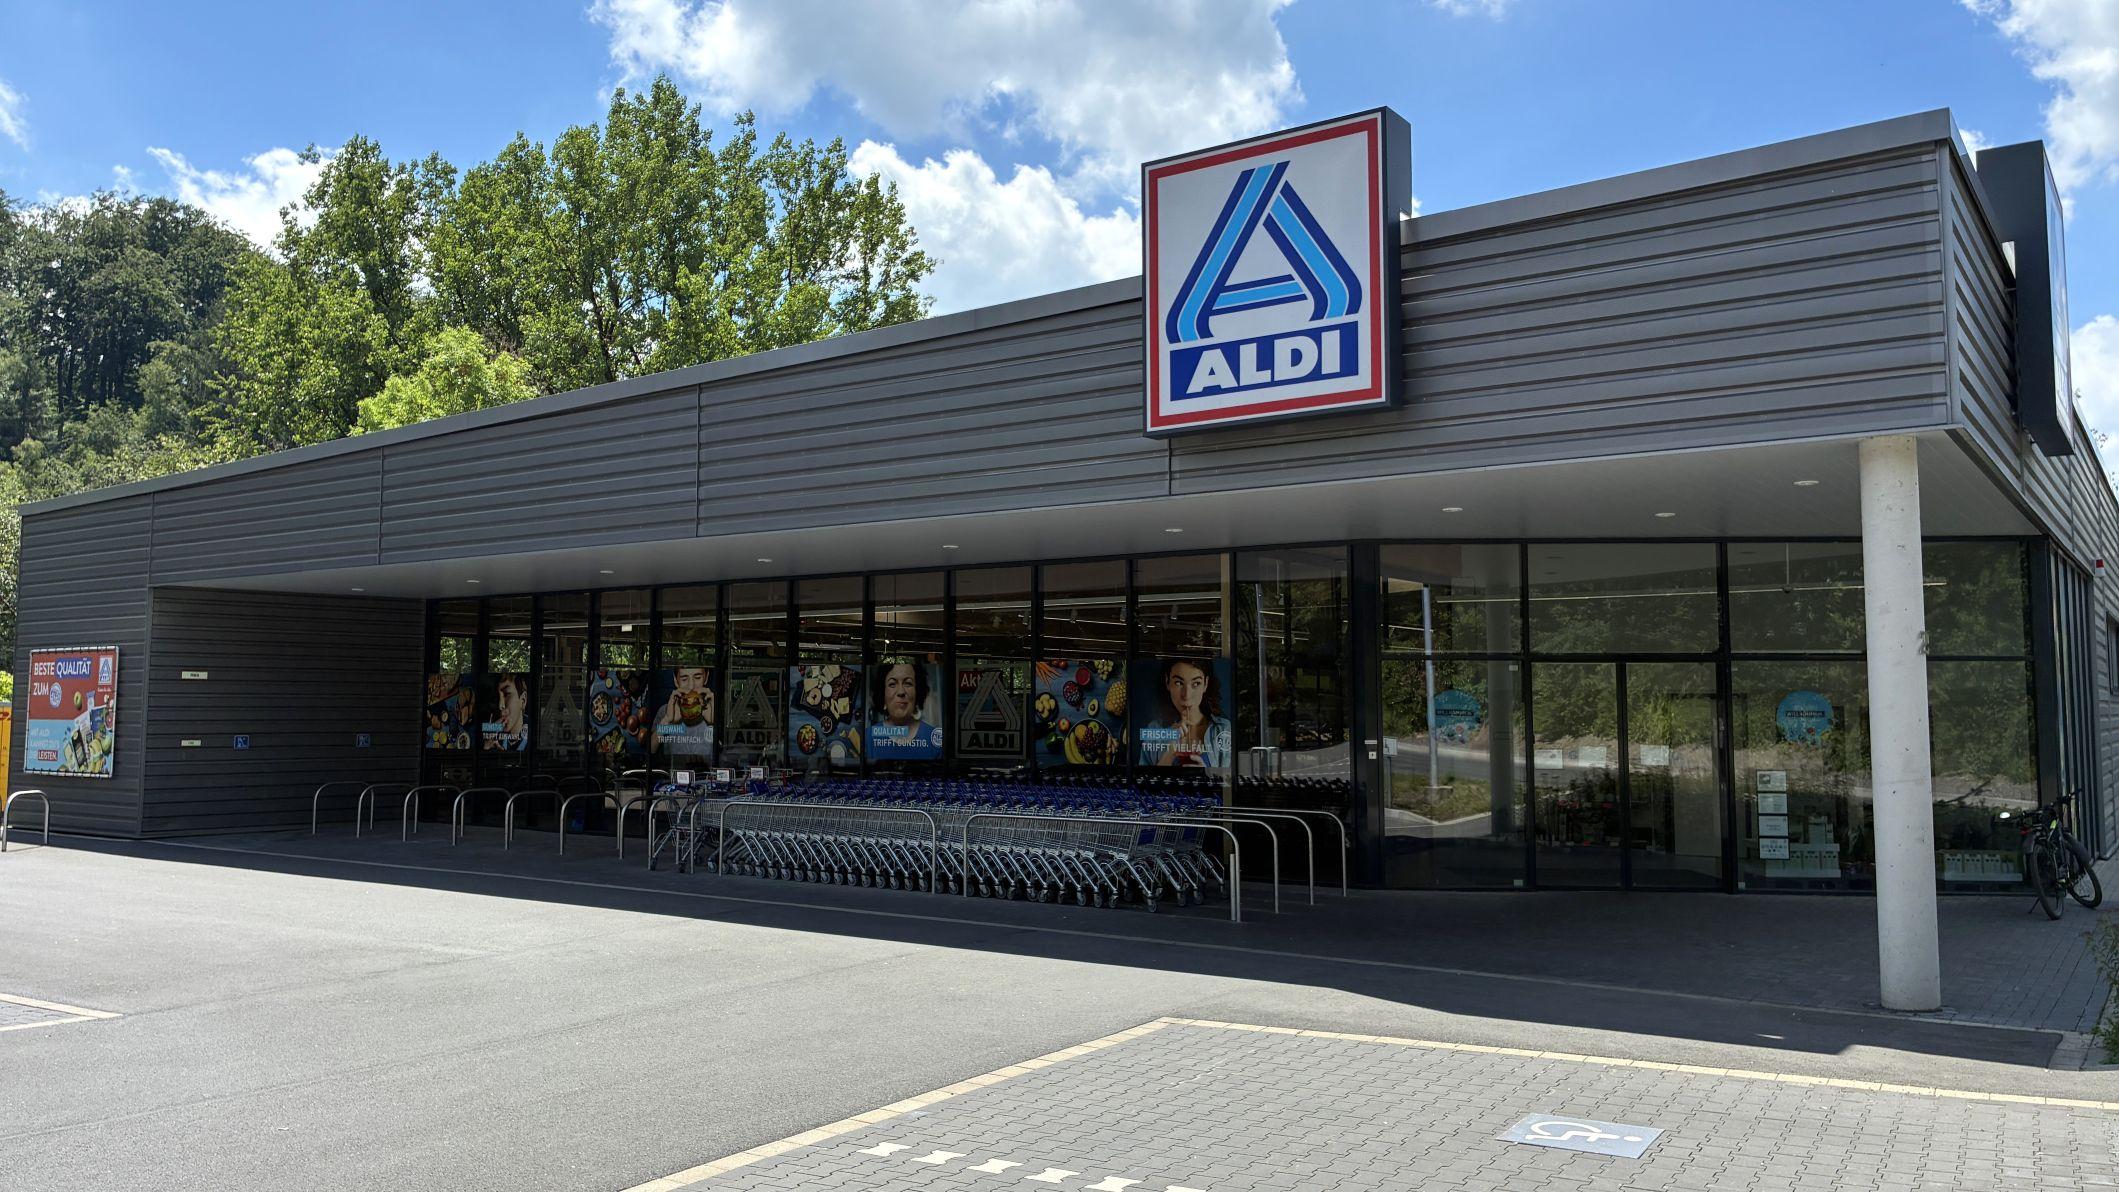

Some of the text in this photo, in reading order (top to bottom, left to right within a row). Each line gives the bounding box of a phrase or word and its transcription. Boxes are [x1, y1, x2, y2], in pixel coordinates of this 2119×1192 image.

[1186, 329, 1341, 395] ALDI
[34, 658, 91, 678] BESTE QUALITÄT
[961, 673, 981, 688] Akt
[33, 682, 49, 696] ZUM
[657, 724, 683, 734] AUSWAHL
[1142, 730, 1177, 739] FRISCHE
[657, 735, 676, 744] TRIFFT
[873, 738, 895, 747] TRIFFT
[967, 732, 1015, 749] ALDI
[1141, 743, 1170, 752] TRIFFT
